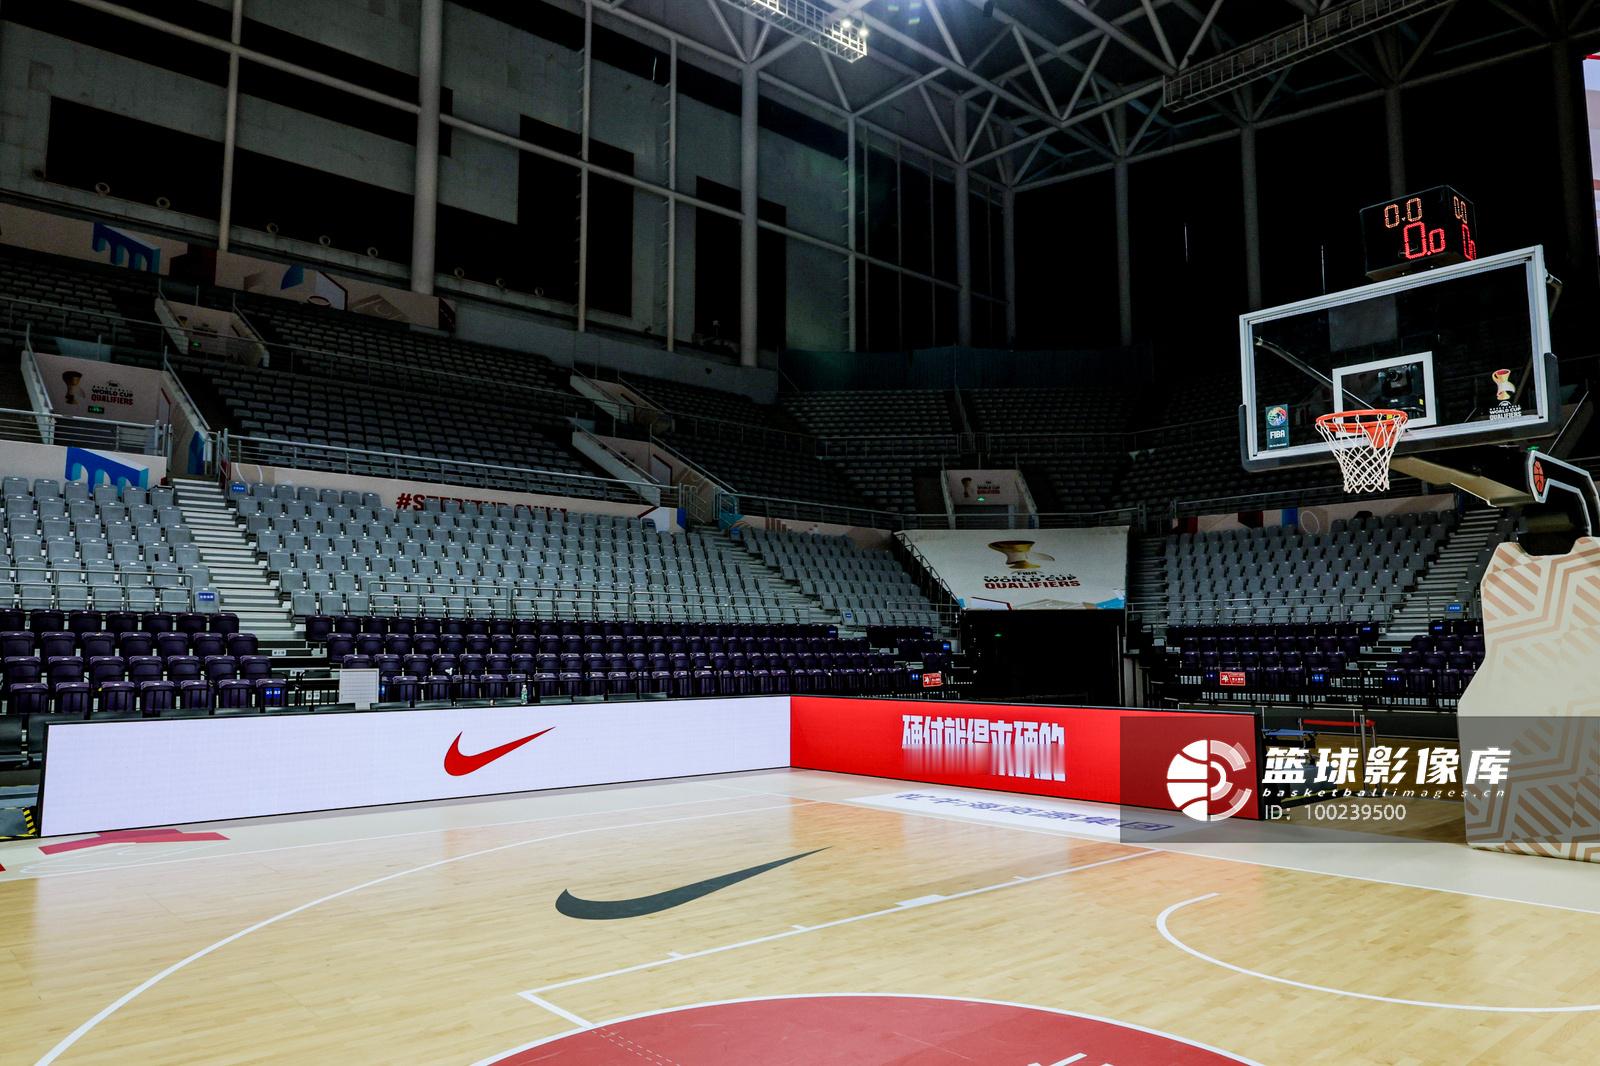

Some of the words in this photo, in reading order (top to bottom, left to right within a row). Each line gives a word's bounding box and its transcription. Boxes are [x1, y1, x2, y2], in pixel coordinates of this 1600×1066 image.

[1384, 197, 1423, 229] 0.0
[1403, 221, 1446, 259] 0.0
[1269, 429, 1286, 440] FIBA
[1045, 574, 1077, 582] CUP
[984, 580, 1081, 590] QUALIFIERS
